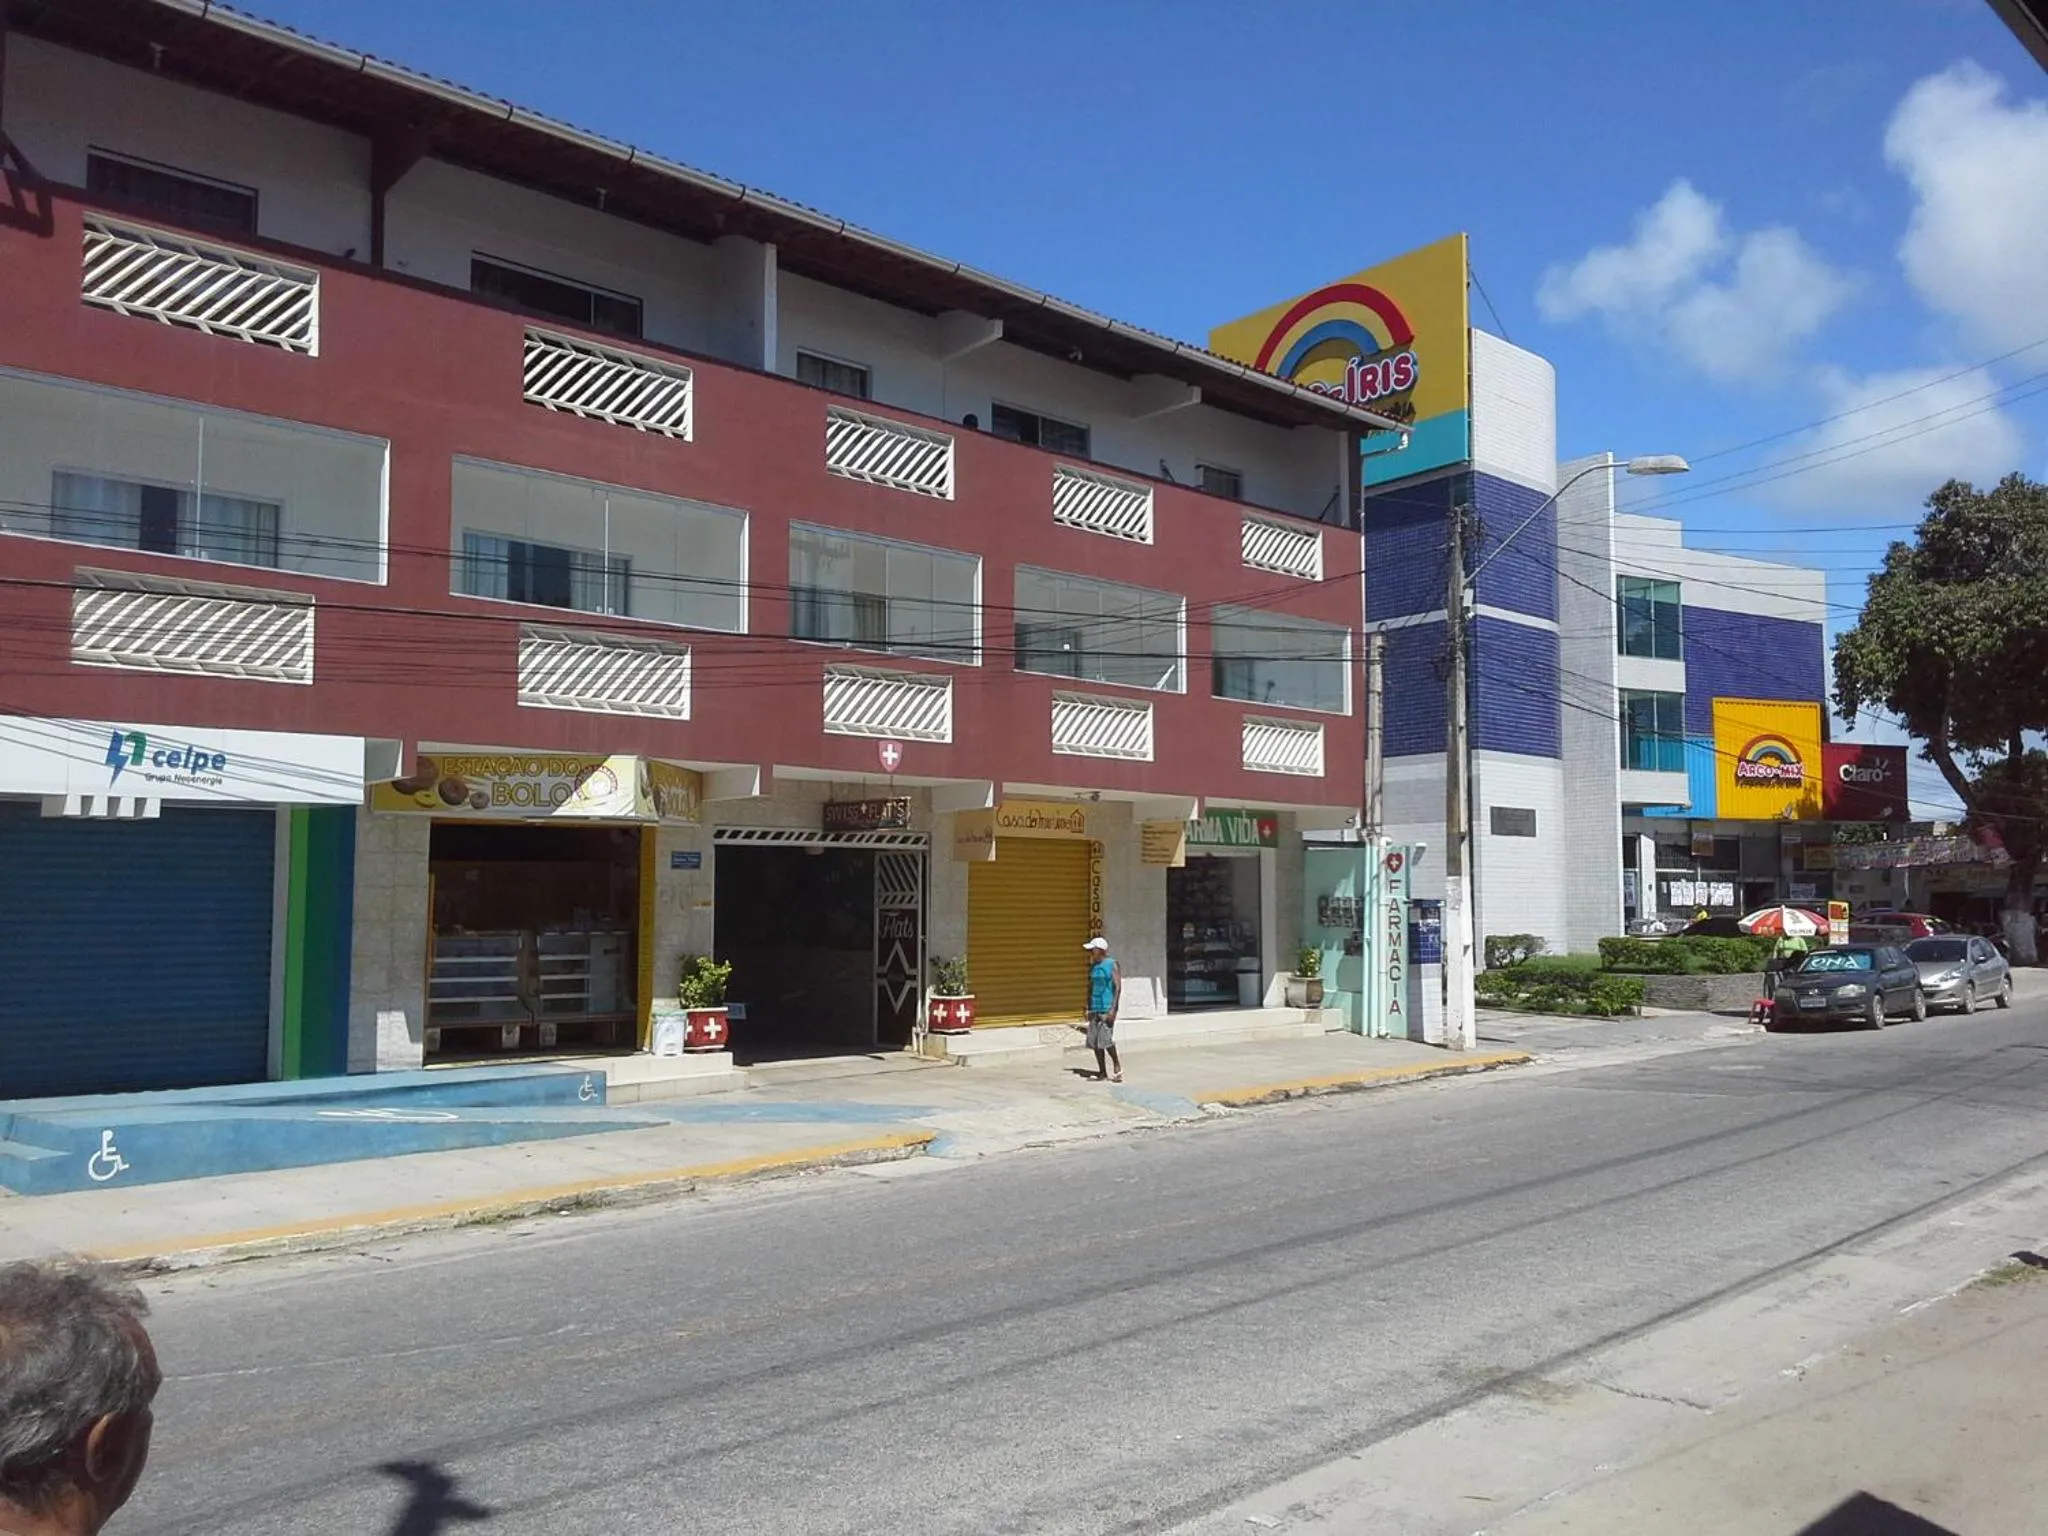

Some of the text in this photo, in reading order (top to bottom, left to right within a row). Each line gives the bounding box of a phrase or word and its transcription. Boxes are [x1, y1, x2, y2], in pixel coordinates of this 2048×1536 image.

[153, 745, 226, 775] celpe
[548, 757, 581, 777] DO
[1738, 761, 1804, 778] ARCO-MIX
[1839, 764, 1883, 782] Claro
[491, 782, 573, 806] BOLO
[1184, 816, 1260, 845] ARMA VIDA
[1388, 879, 1402, 1015] FARMACIA
